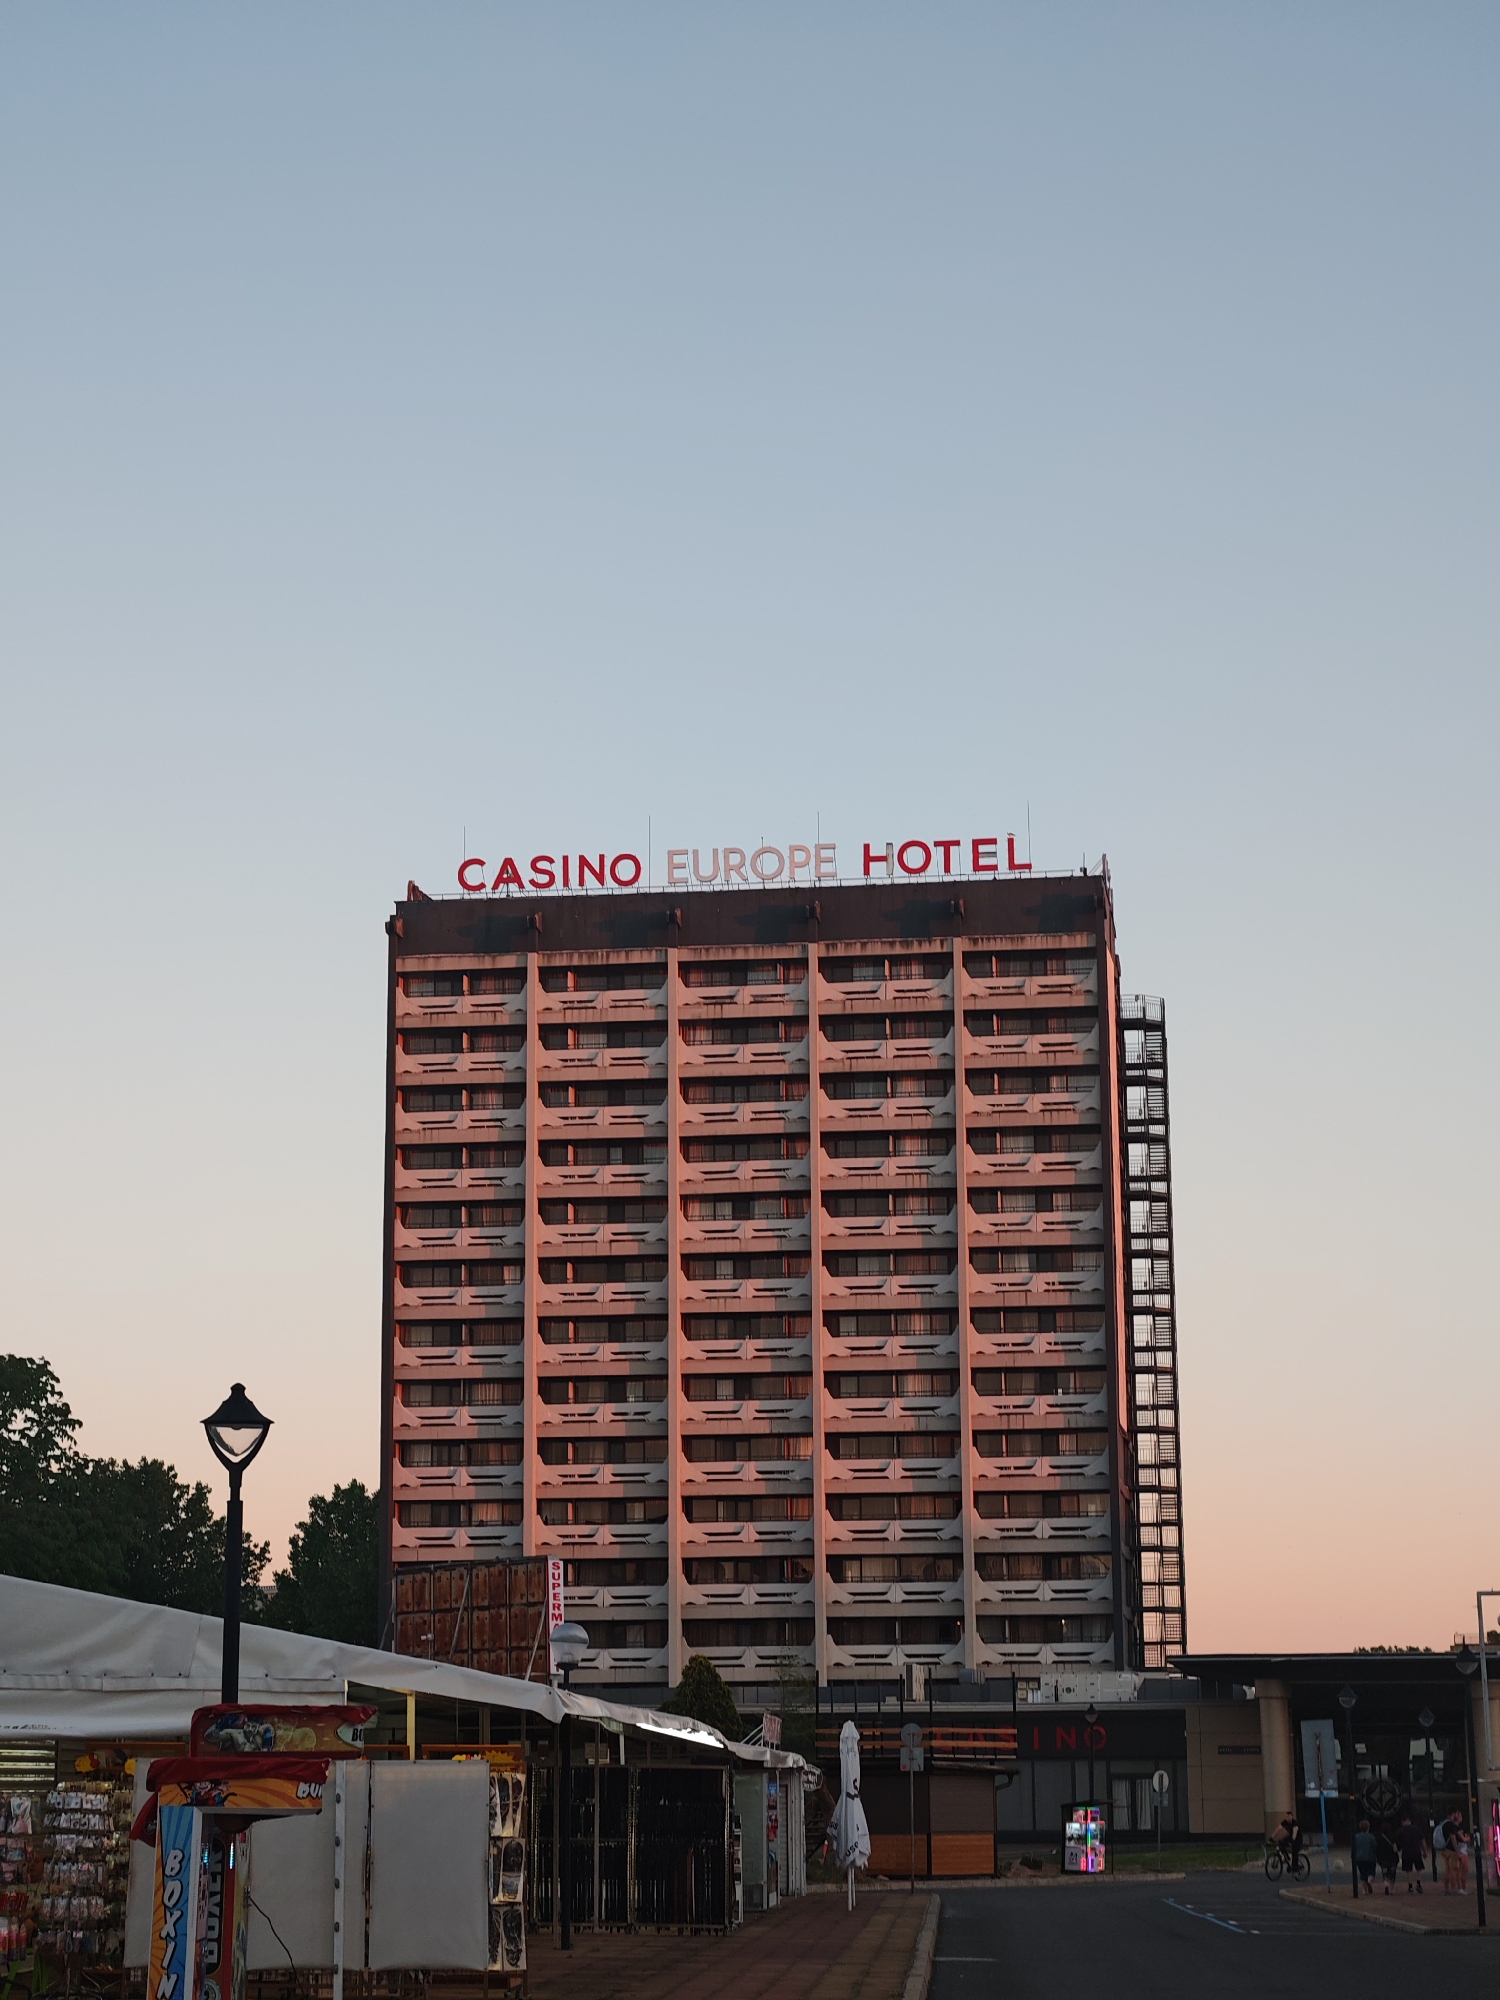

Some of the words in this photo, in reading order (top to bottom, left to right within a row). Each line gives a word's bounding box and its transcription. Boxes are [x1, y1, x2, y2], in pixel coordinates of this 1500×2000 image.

[457, 853, 641, 892] CASINO
[667, 842, 836, 884] EUROPE
[863, 837, 1032, 877] HOTEL
